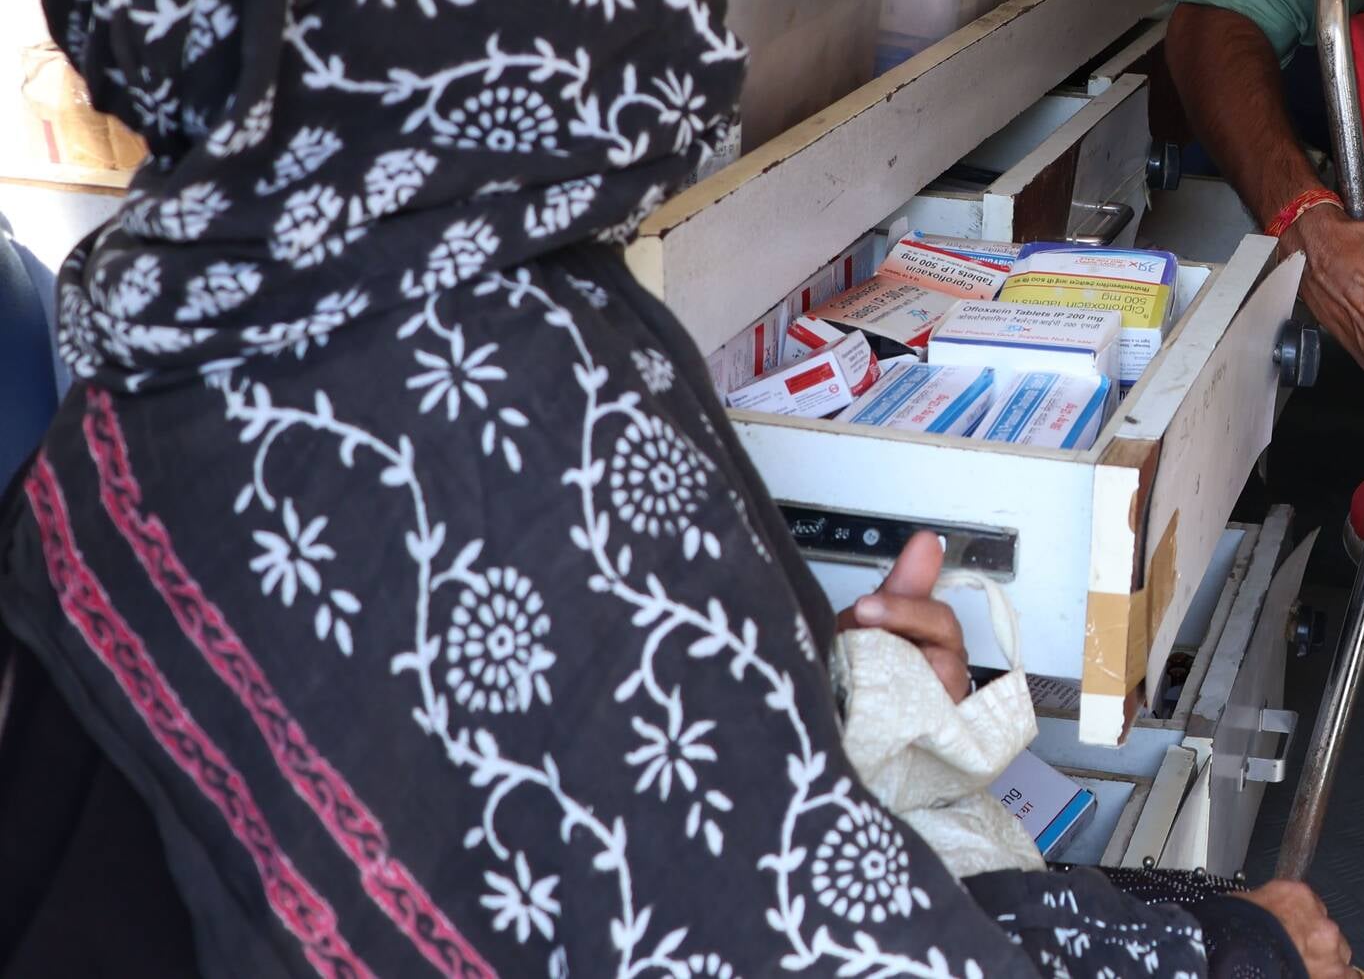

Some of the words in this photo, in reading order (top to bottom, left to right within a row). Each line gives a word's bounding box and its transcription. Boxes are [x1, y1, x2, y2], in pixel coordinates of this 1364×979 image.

[919, 258, 939, 269] 500
[940, 264, 956, 276] I.P.
[905, 264, 974, 291] Ciprofloxacin
[958, 268, 994, 287] Tablets
[1101, 293, 1122, 302] mg
[1124, 295, 1148, 304] 500
[962, 304, 1012, 315] Ofloxacin
[1014, 309, 1051, 318] Tablets
[1066, 299, 1145, 315] Ciprofloxacin
